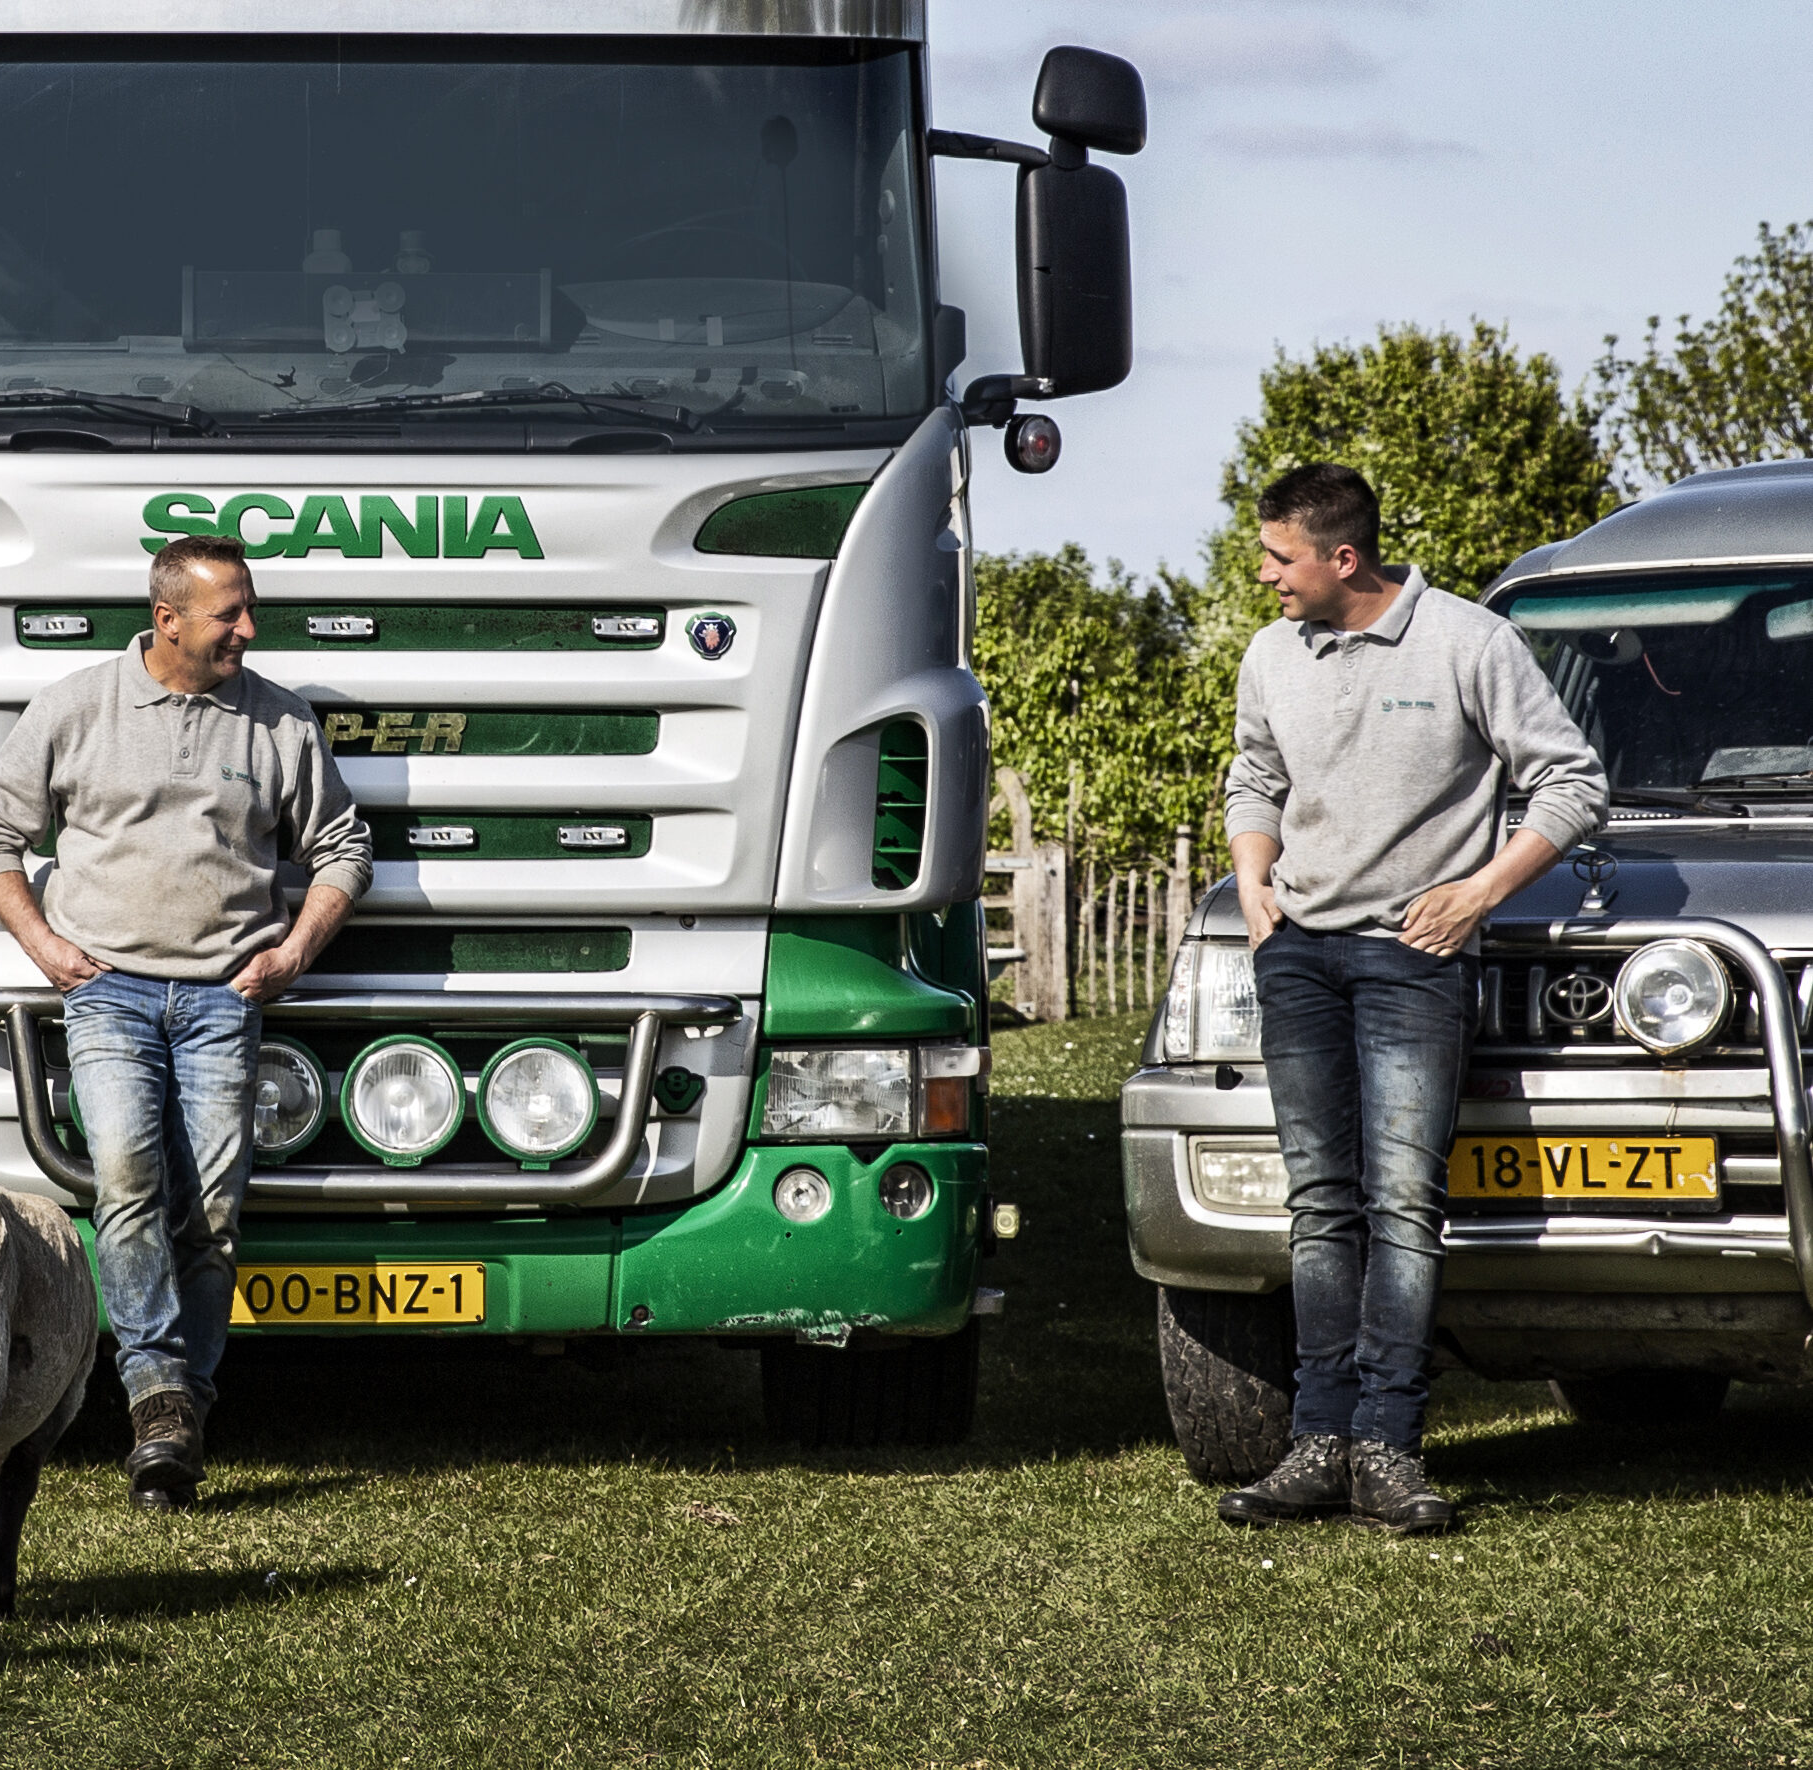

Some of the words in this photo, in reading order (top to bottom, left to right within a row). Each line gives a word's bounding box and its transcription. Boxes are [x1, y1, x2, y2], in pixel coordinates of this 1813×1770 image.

[139, 492, 545, 559] SCANIA
[324, 712, 467, 752] PER
[1471, 1144, 1682, 1189] 18-VL-ZT
[246, 1272, 463, 1315] 00-BNZ-1
